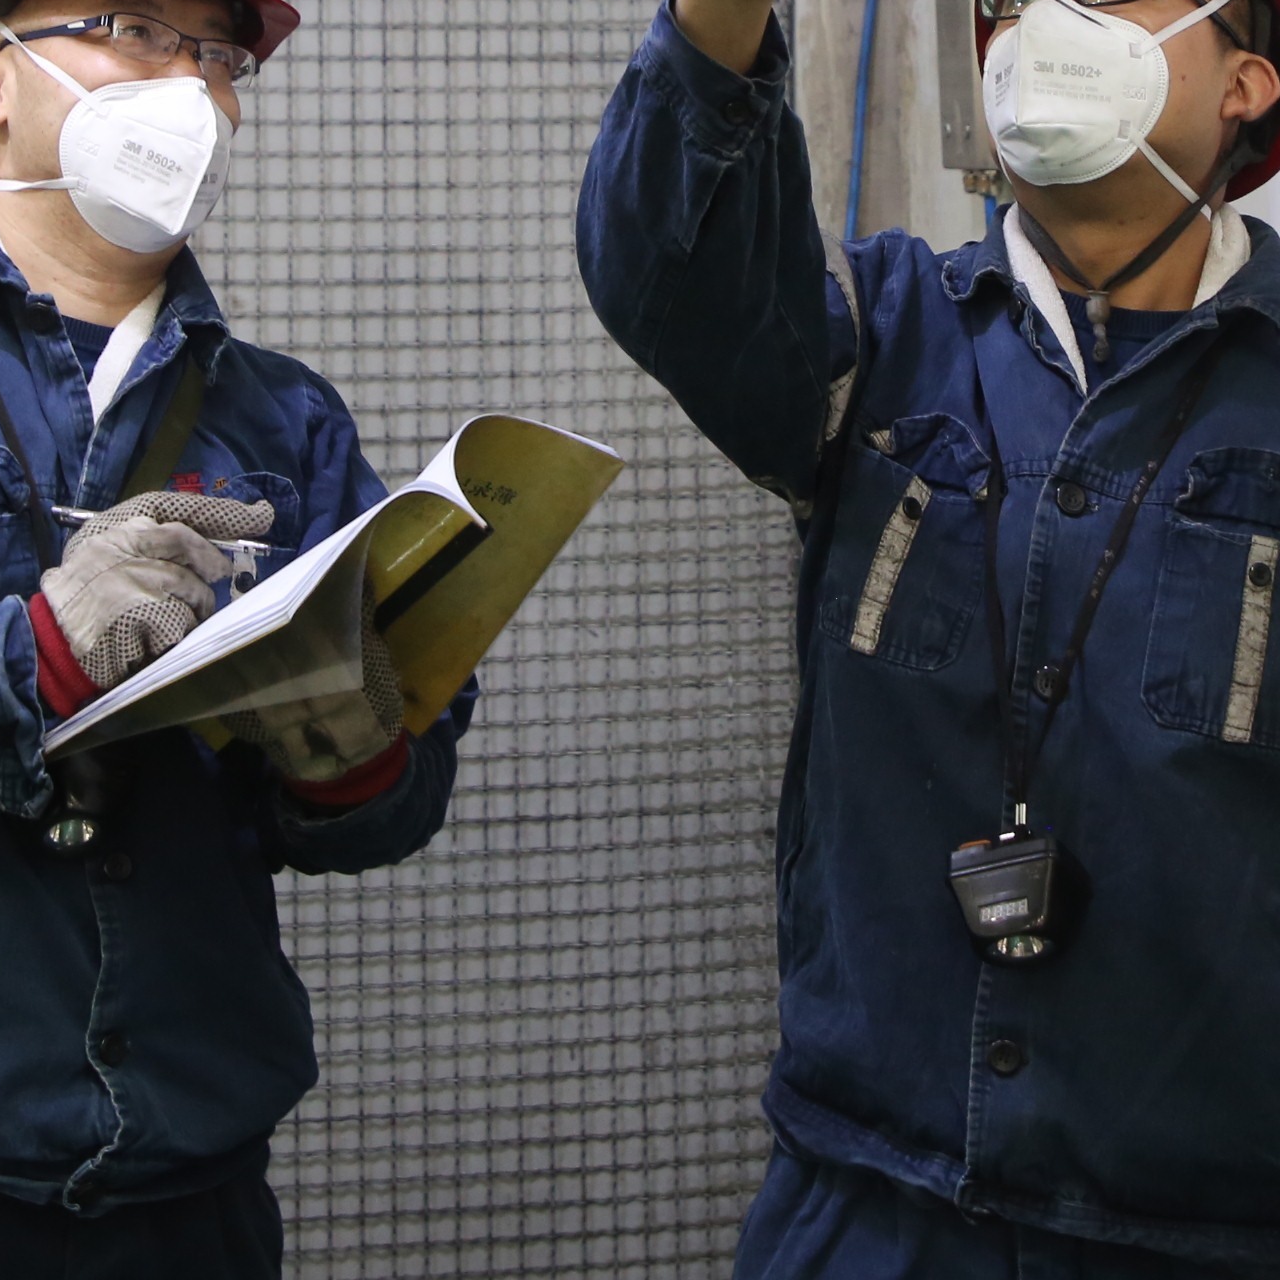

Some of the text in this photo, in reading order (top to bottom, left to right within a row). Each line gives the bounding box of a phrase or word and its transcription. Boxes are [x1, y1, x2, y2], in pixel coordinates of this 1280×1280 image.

[1033, 60, 1102, 78] 3M 9502+
[122, 139, 143, 155] 3M
[146, 149, 184, 174] 9502+
